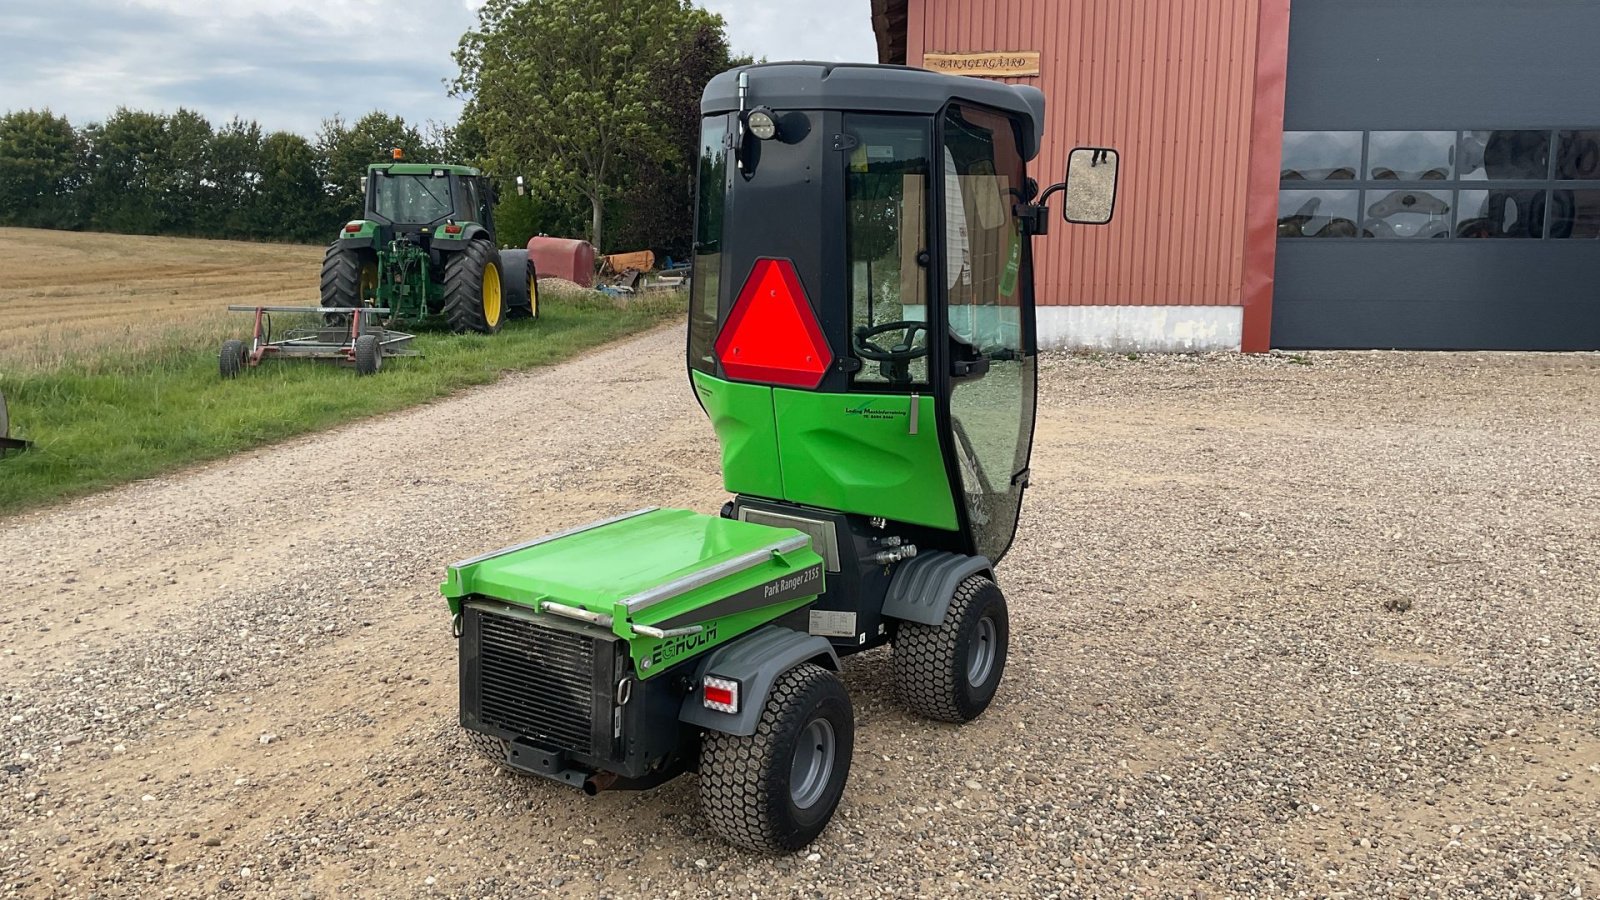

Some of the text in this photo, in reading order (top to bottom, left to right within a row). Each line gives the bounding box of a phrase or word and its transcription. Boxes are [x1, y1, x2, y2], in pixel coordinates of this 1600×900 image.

[764, 567, 819, 598] Park Ranger 2155
[652, 622, 717, 664] EGHOLM
